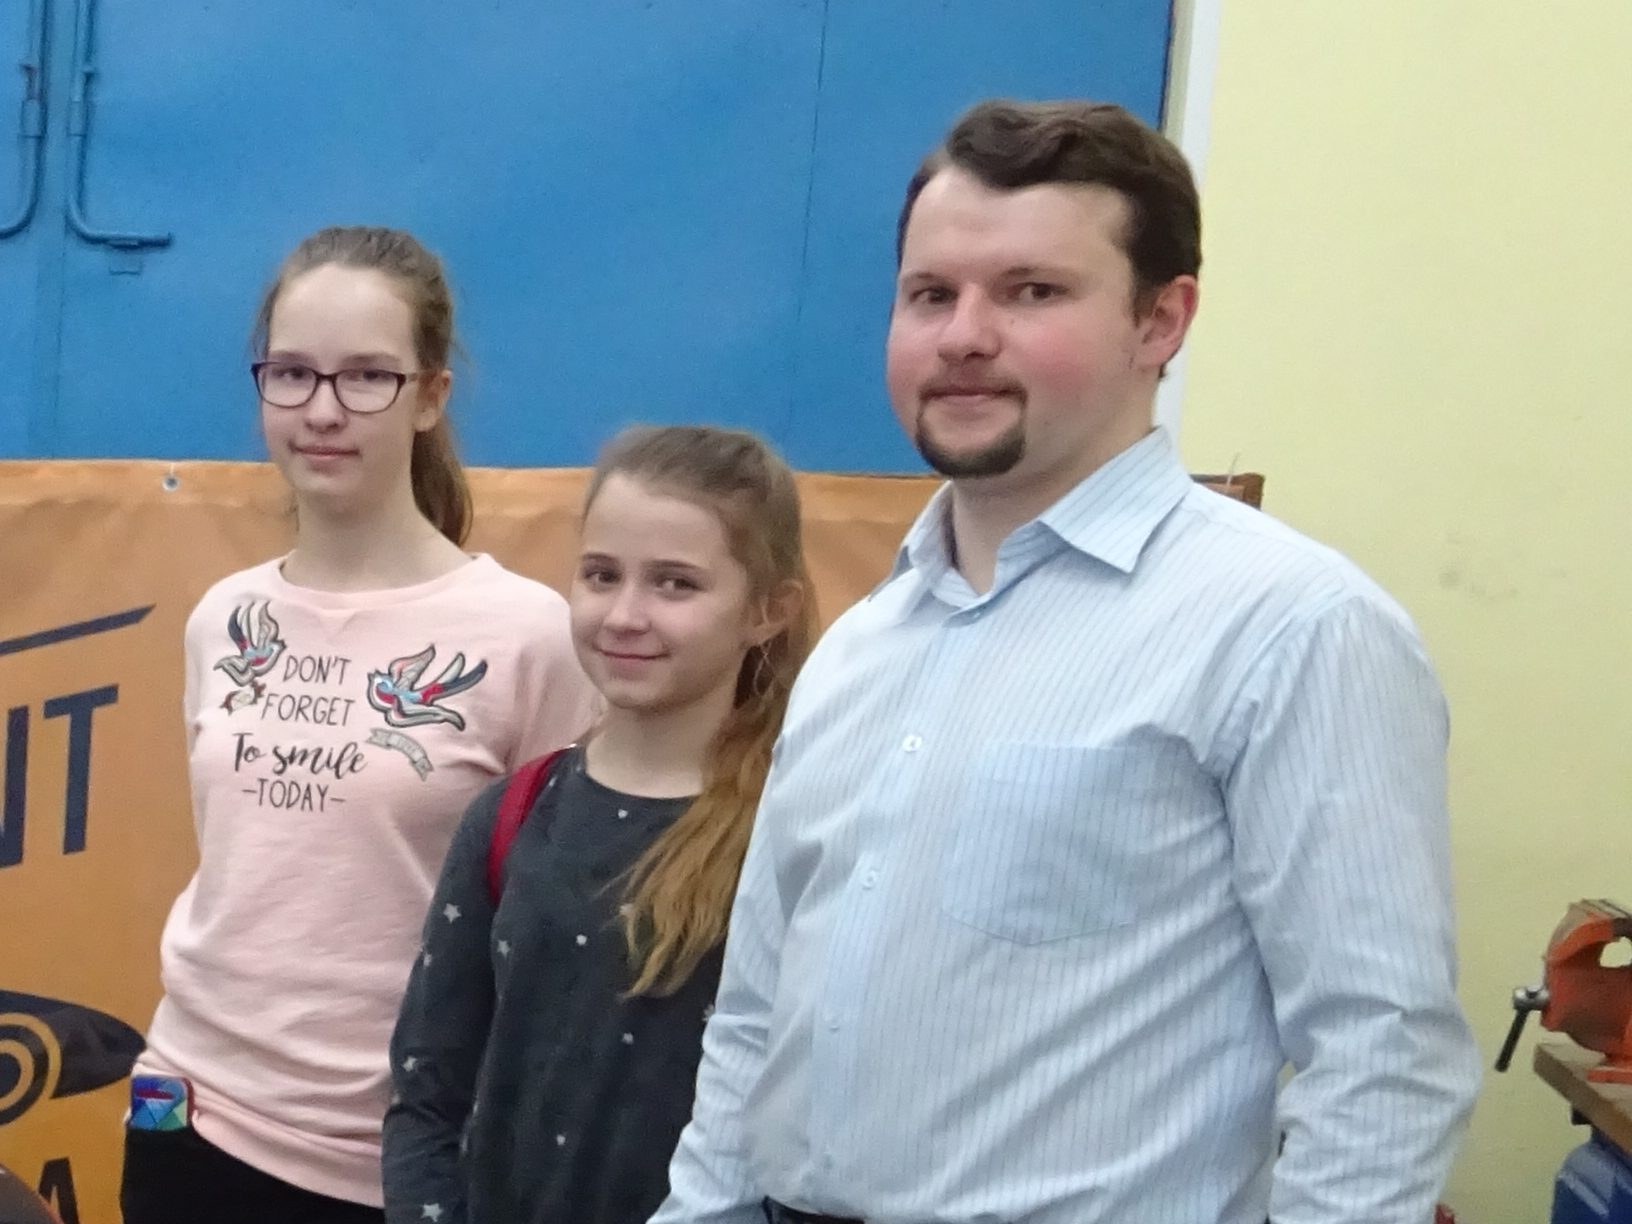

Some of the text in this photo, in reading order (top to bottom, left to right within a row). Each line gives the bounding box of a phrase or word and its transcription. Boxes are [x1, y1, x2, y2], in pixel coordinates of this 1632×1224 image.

[283, 655, 352, 685] DON'T
[261, 693, 356, 726] FORGET
[233, 732, 369, 779] To smile
